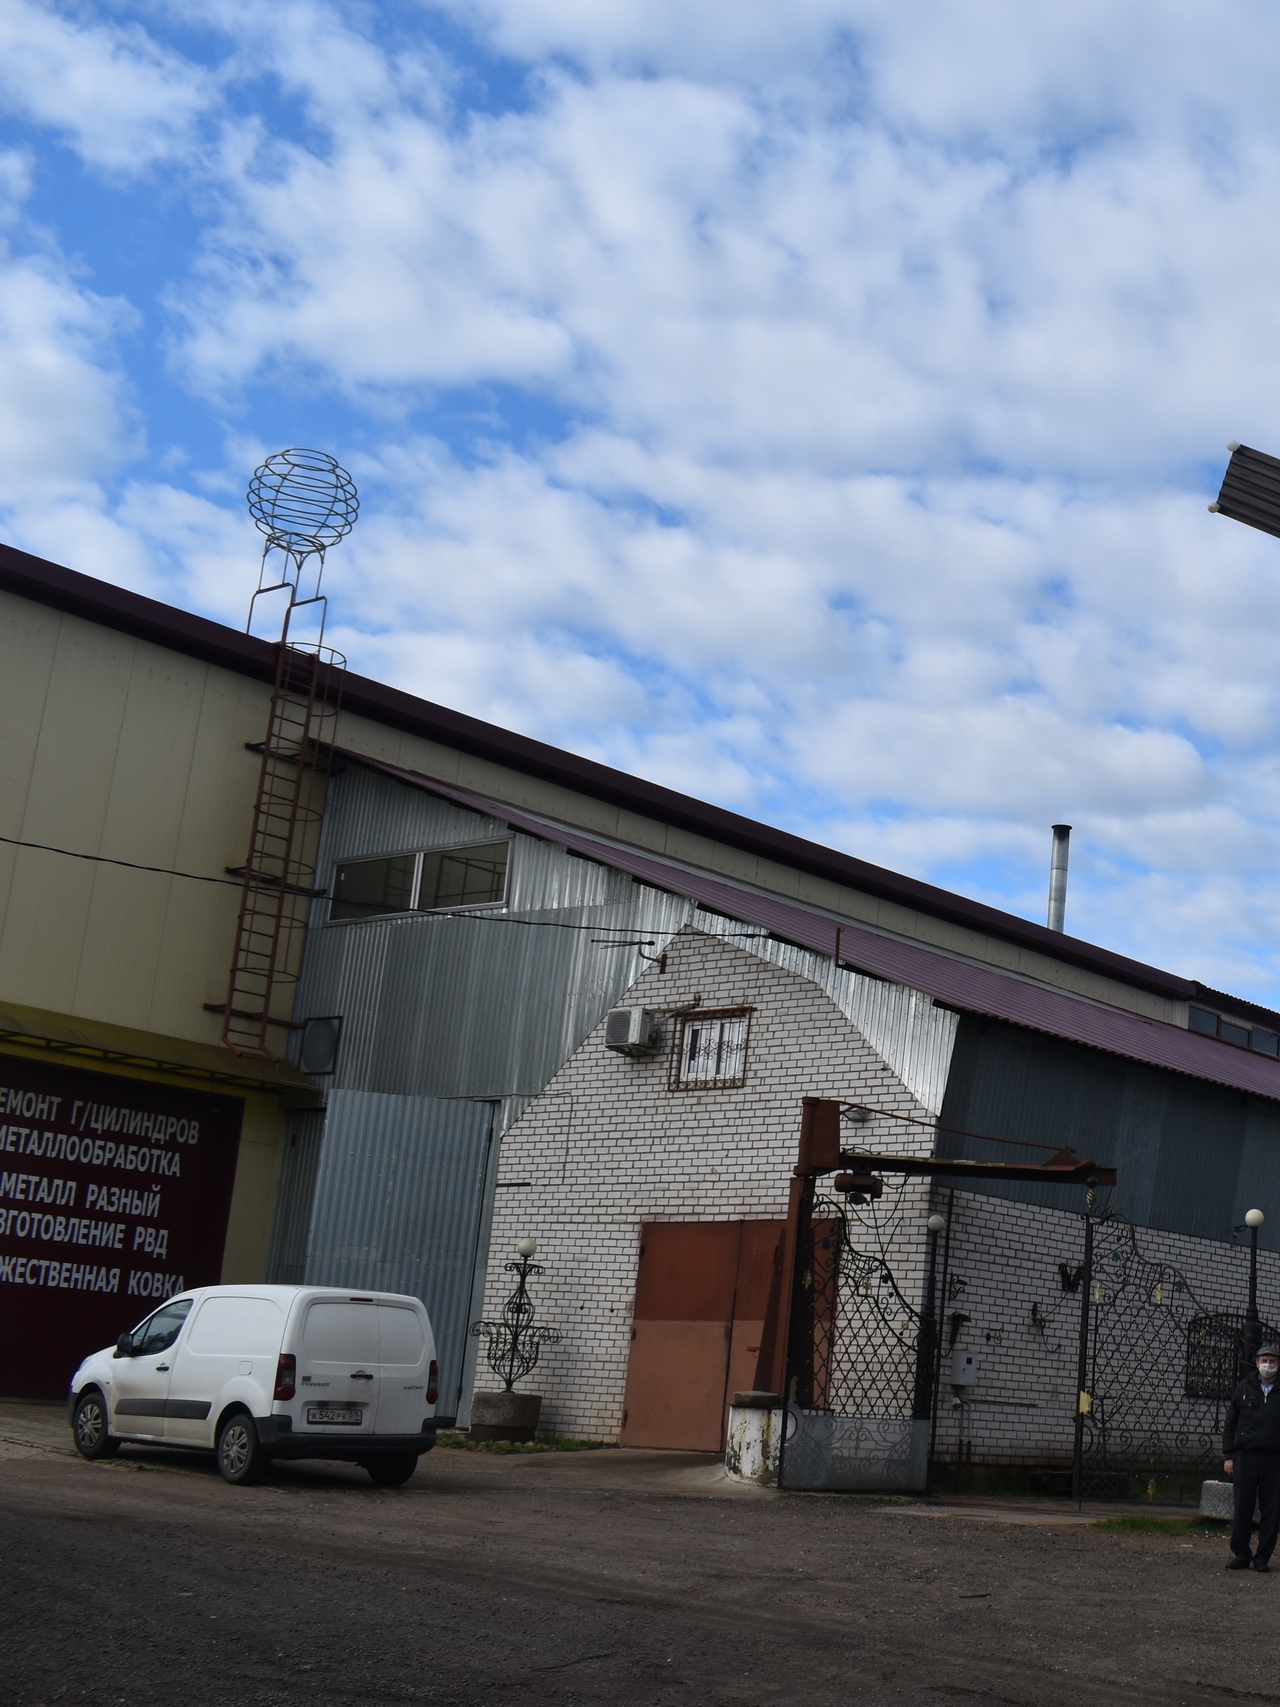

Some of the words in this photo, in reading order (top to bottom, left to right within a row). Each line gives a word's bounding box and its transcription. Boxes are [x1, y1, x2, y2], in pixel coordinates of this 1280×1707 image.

[71, 1100, 200, 1144] Г/ЦИЛИНДРОВ
[0, 1171, 77, 1206] МЕТАЛЛ
[86, 1184, 161, 1218] РАЗНЫЙ
[133, 1226, 169, 1259] РВД
[127, 1269, 185, 1298] КОВКА
